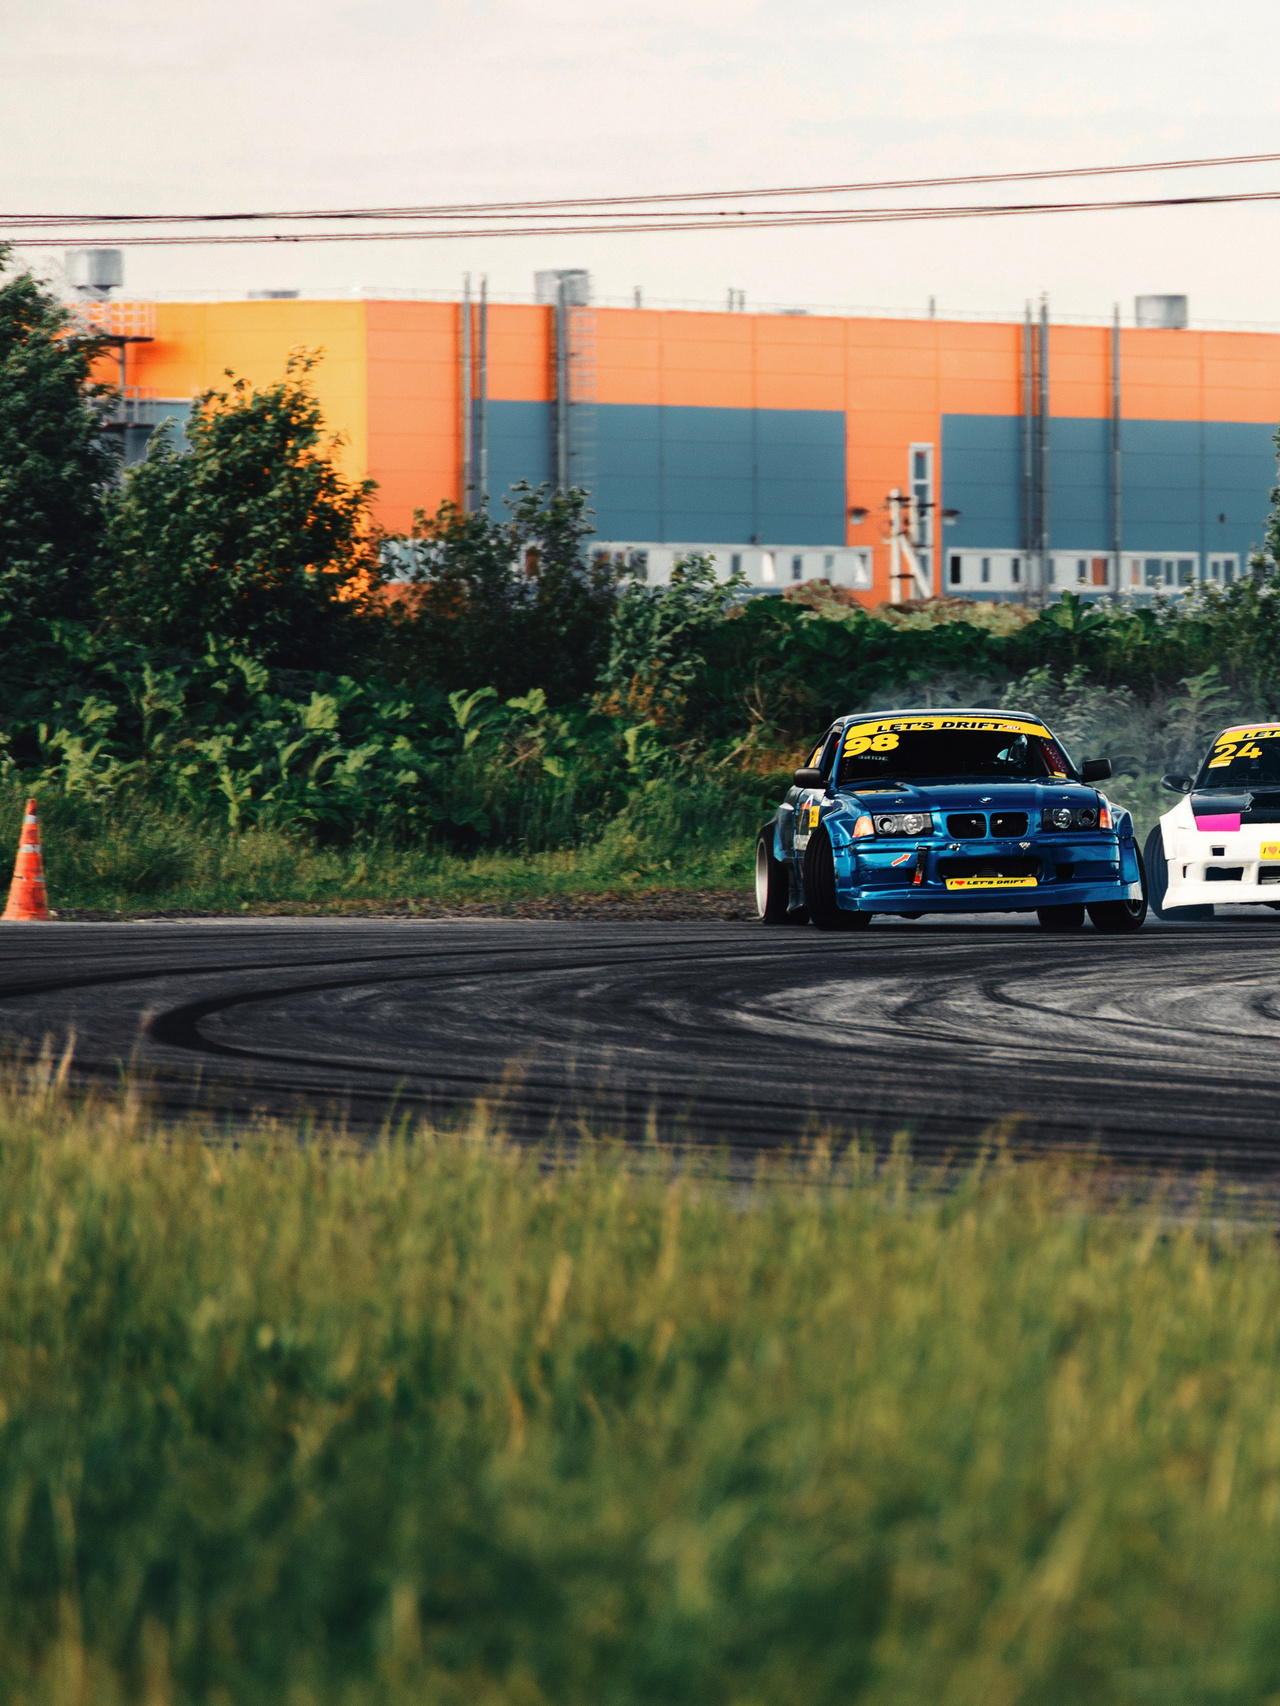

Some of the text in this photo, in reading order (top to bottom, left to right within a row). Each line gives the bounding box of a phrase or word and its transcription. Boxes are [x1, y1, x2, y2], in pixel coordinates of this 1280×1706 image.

[876, 721, 935, 732] LET'S
[842, 733, 900, 758] 98
[1210, 741, 1263, 763] 24
